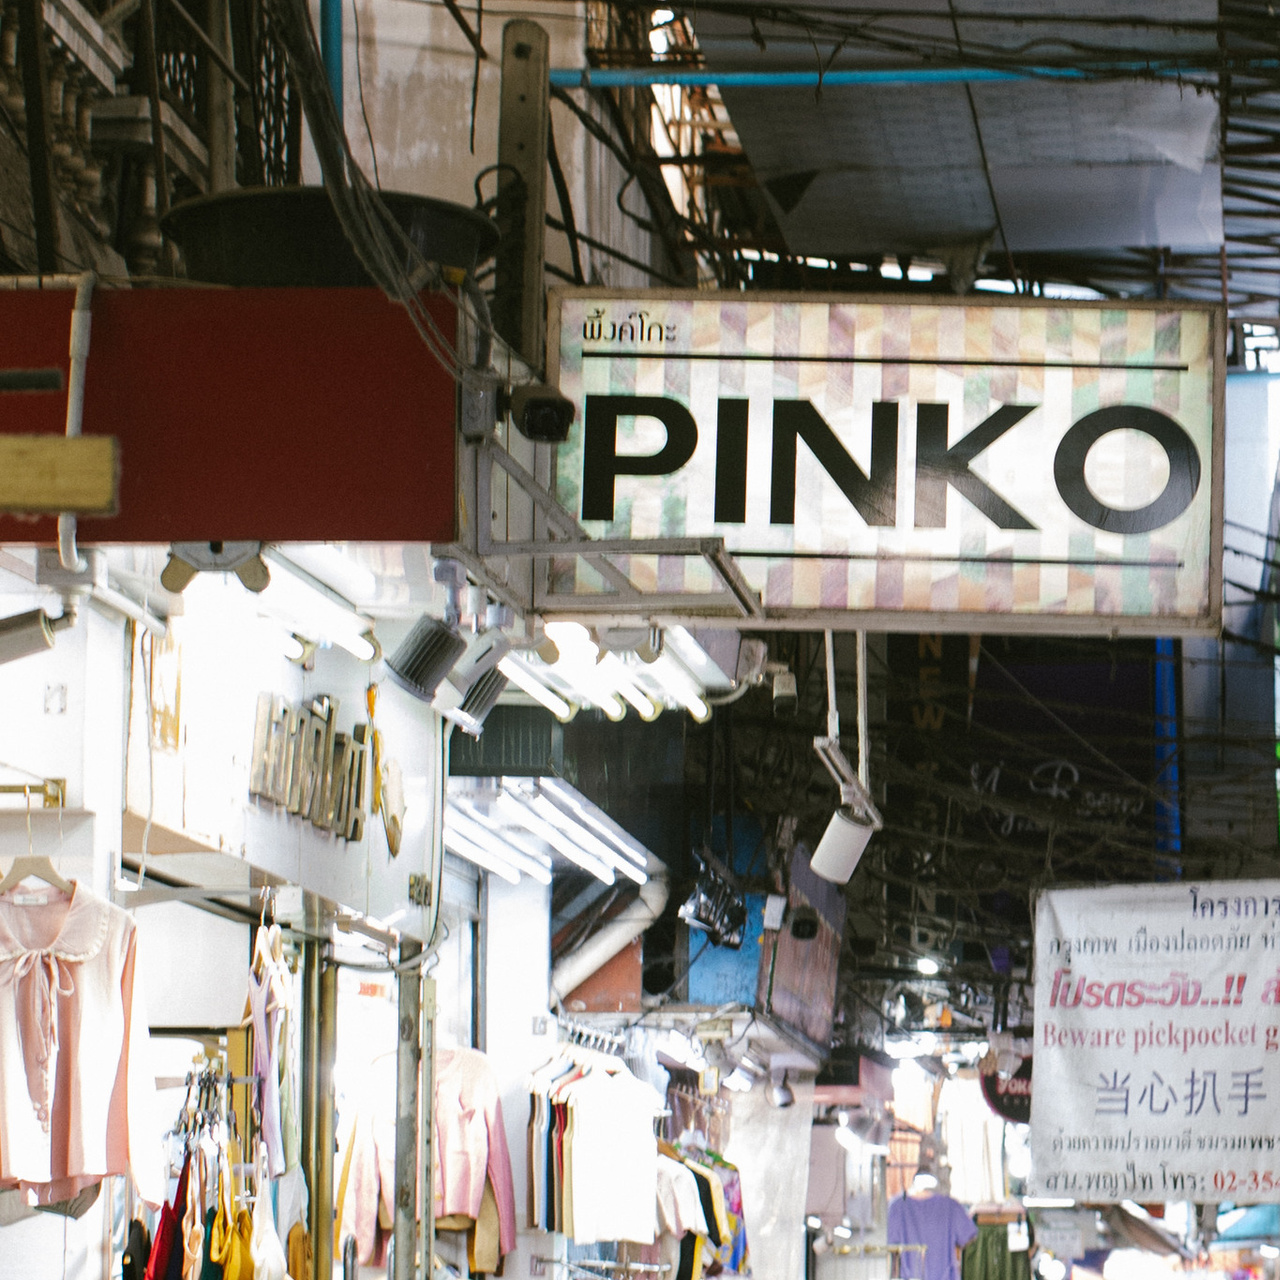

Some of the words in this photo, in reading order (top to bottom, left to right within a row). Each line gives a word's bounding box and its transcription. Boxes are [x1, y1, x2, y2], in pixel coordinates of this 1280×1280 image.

[581, 394, 1201, 535] PINKO
[1042, 1024, 1126, 1049] Beware
[1134, 1020, 1257, 1055] pickpocket
[1094, 1066, 1268, 1119] 当心扒手
